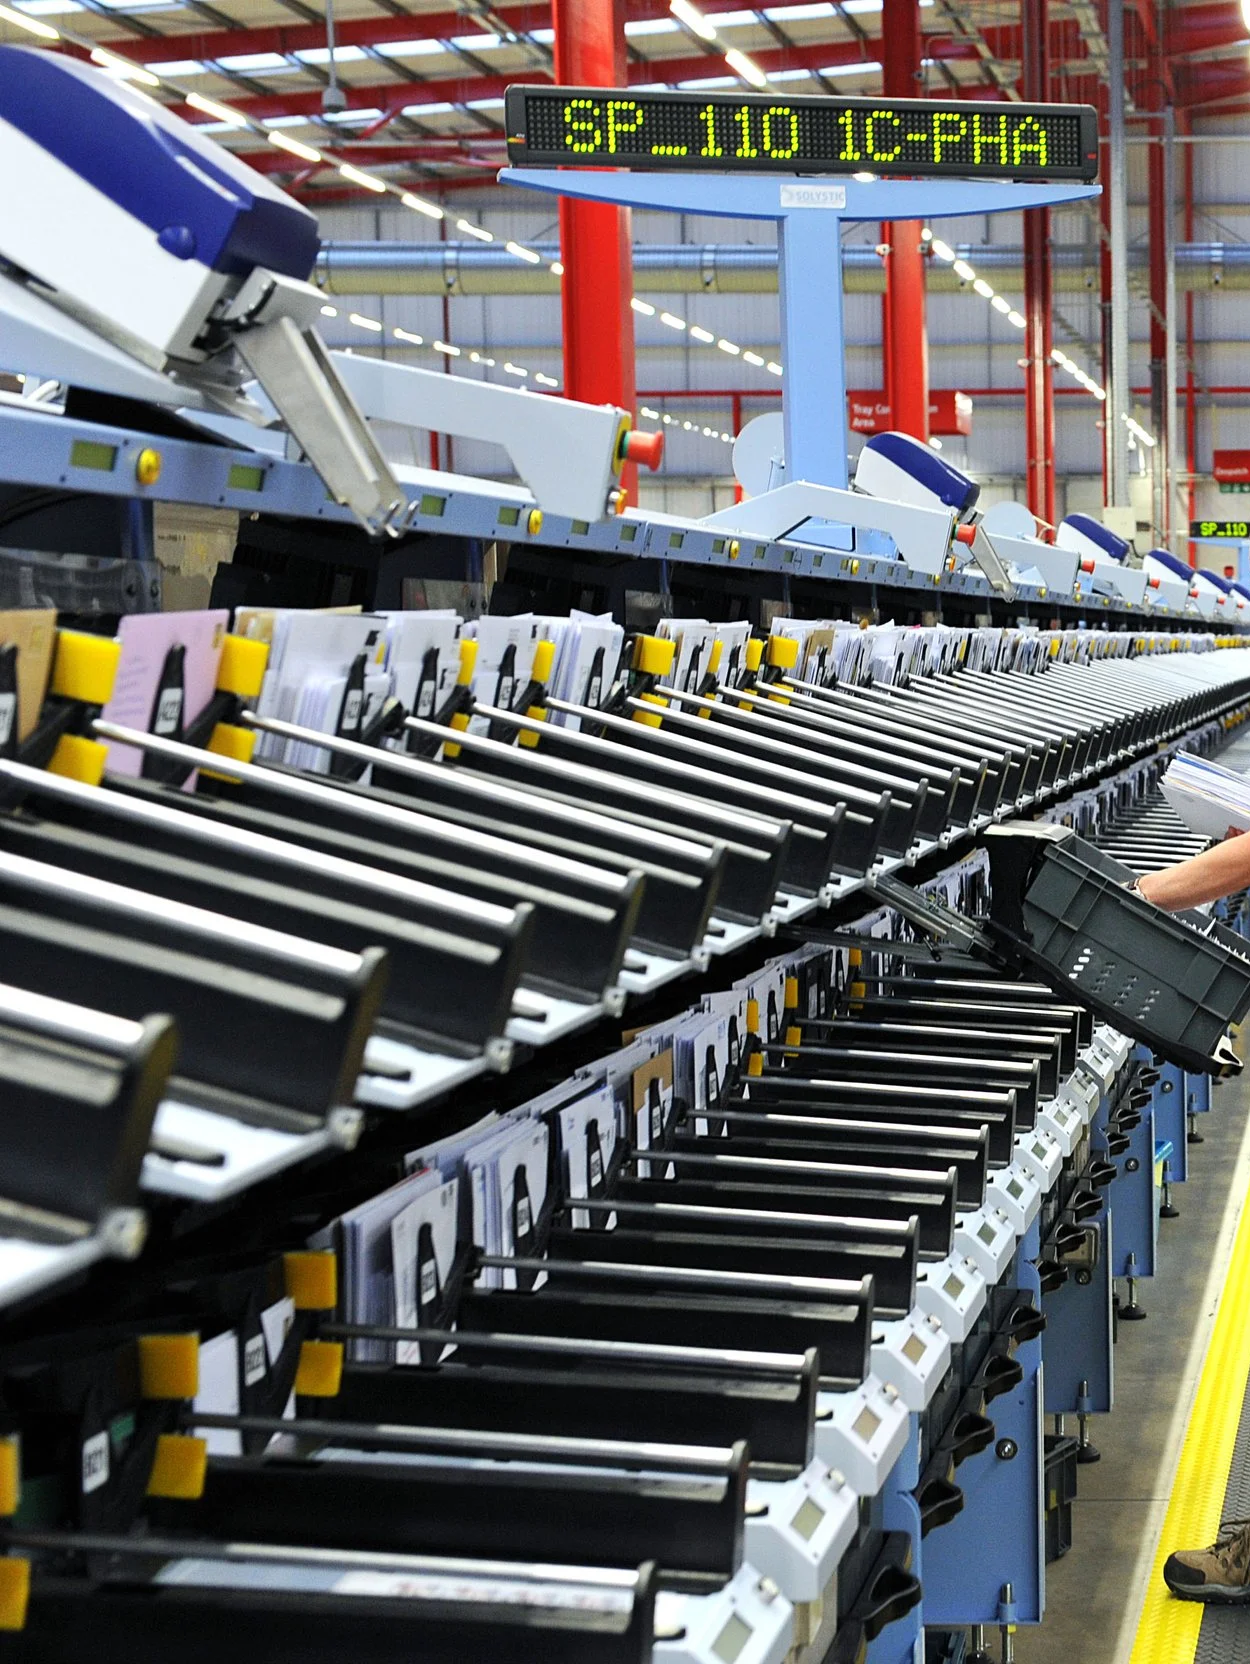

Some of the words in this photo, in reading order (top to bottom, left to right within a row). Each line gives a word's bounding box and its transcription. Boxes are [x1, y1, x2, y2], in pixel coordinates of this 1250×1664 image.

[564, 99, 799, 159] SP_110
[838, 109, 1049, 166] 1C-PHA
[796, 191, 846, 201] SOLYSTIC
[1200, 522, 1248, 537] SP_110
